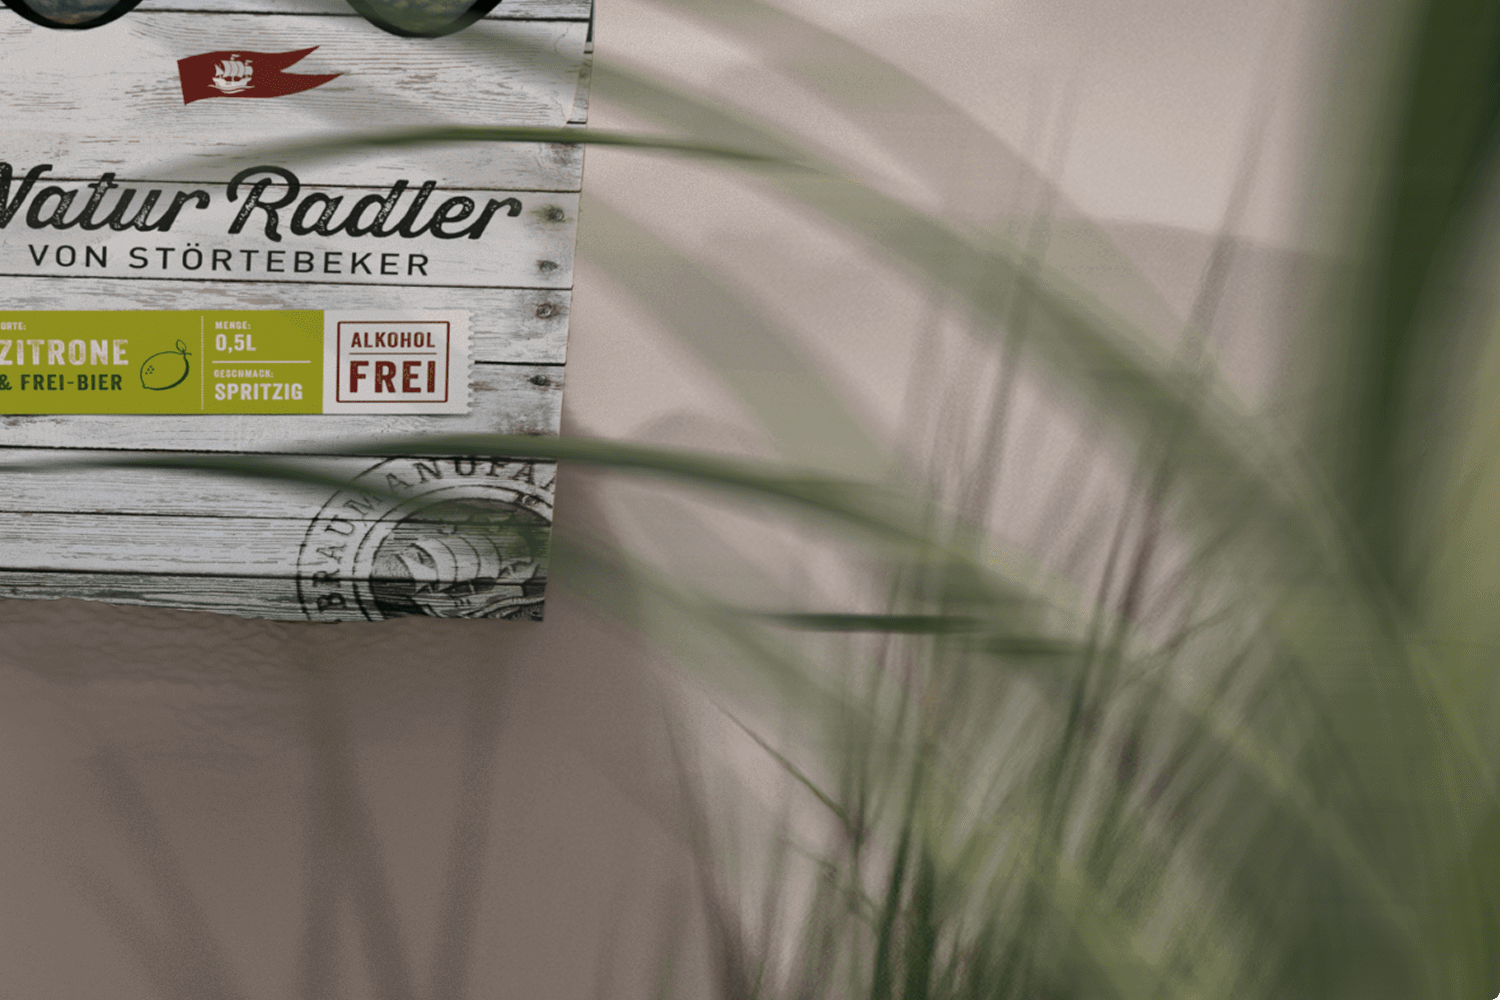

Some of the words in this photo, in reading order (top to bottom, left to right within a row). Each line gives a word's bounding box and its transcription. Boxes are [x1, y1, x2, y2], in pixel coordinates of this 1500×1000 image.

[226, 164, 523, 243] Radler
[28, 244, 108, 269] VON
[129, 243, 430, 276] STÖRTEBEKER
[215, 321, 251, 330] MENGE:
[215, 334, 257, 354] 0,5L
[351, 332, 436, 348] ALKOHOL
[20, 374, 122, 391] FREI-BIER
[214, 369, 274, 378] GESCHMACK:
[350, 361, 436, 393] FREI
[215, 383, 303, 401] SPRITZIG
